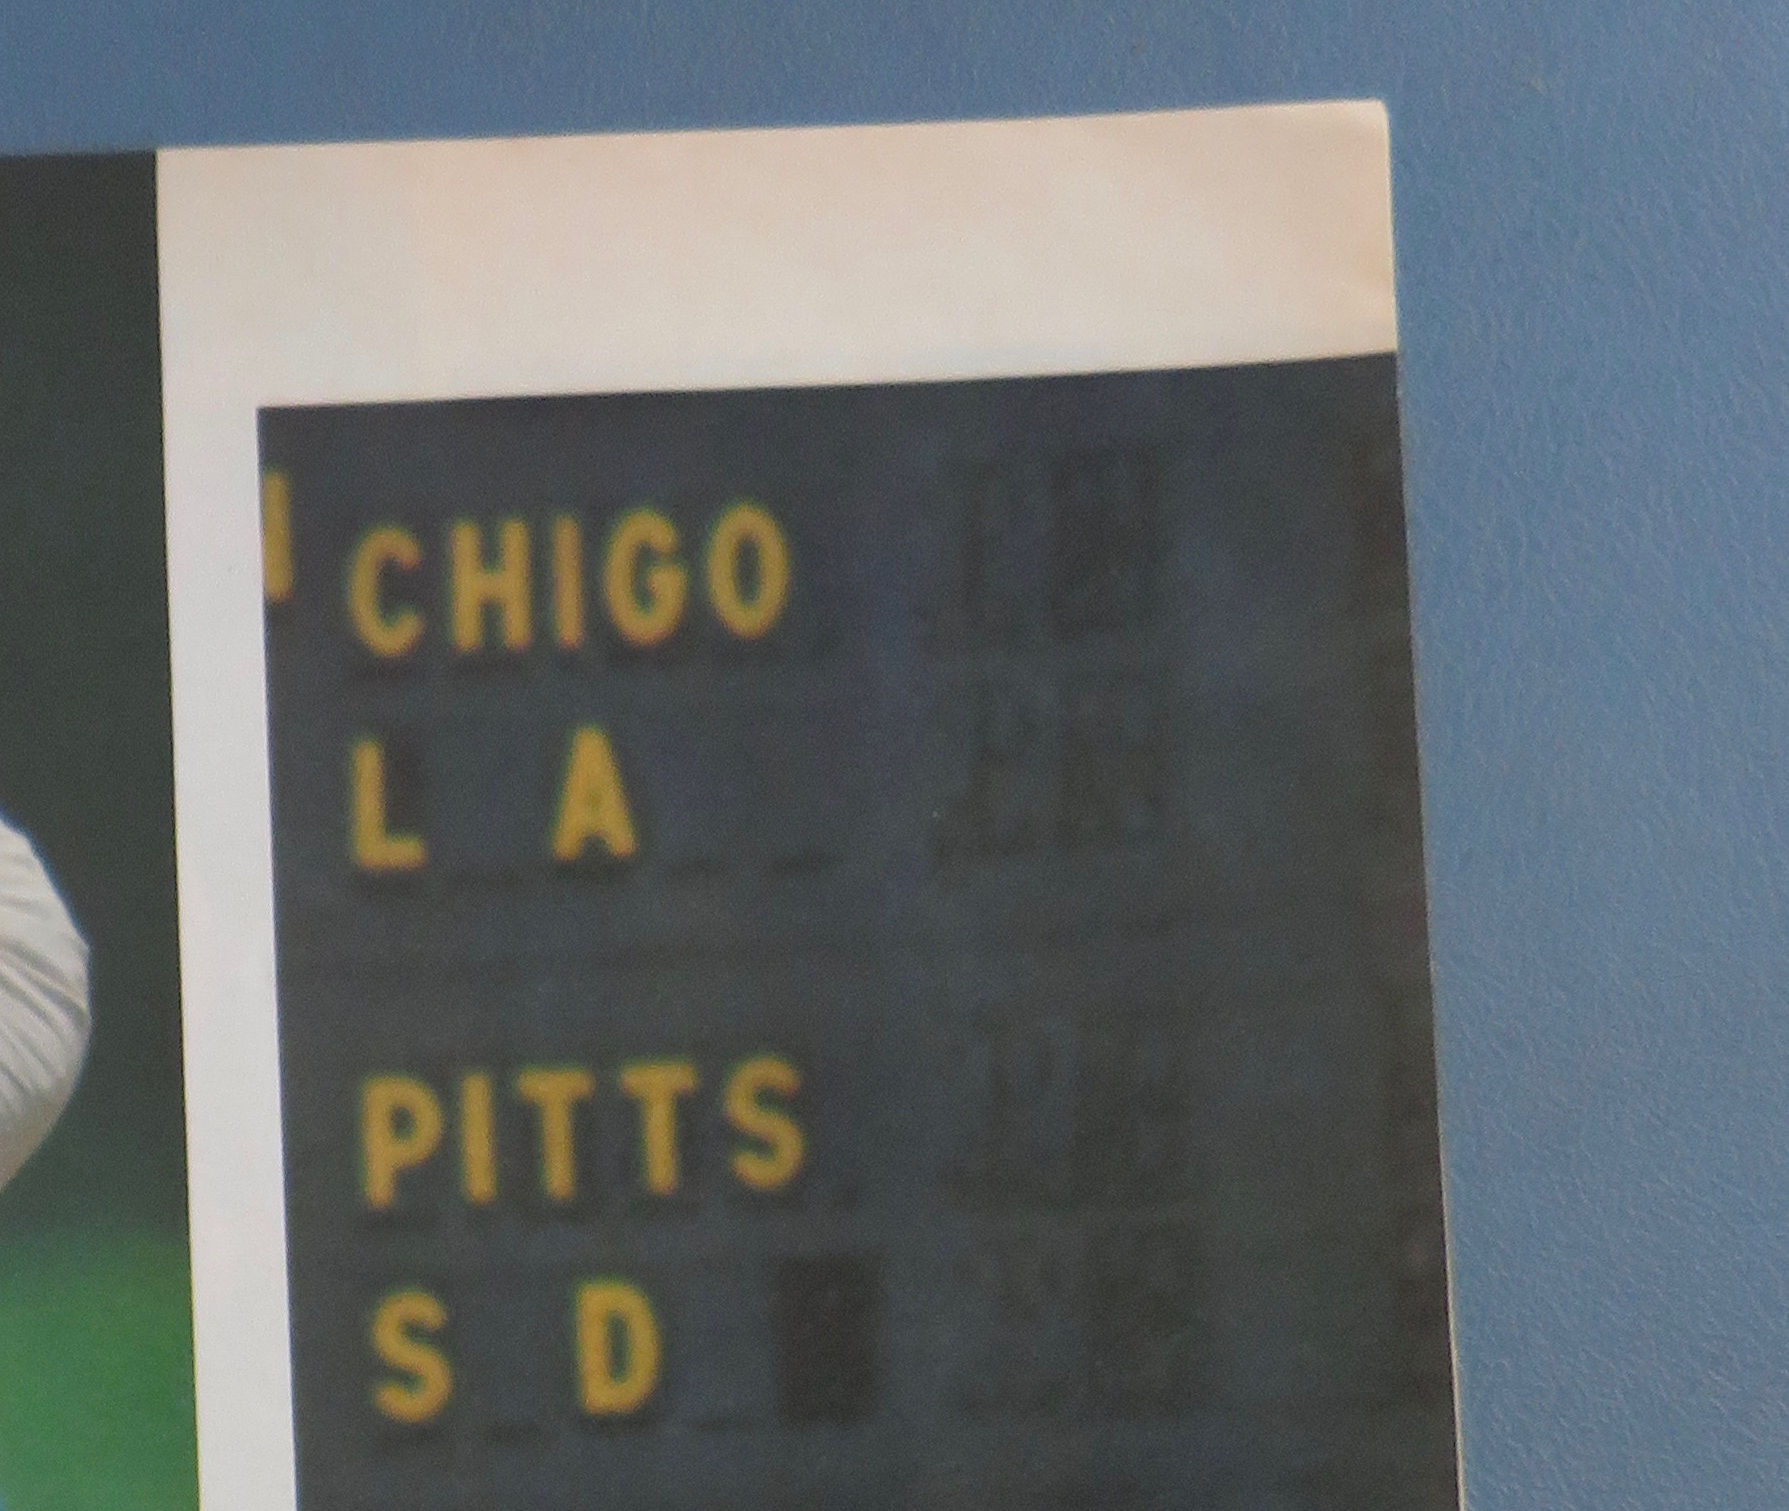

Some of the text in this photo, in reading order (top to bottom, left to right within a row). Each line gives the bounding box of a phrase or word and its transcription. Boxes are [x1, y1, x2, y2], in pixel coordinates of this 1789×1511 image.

[347, 500, 792, 659] CHIGO
[351, 726, 639, 872] L A
[360, 1053, 807, 1208] PITTS
[370, 1277, 663, 1426] S D
